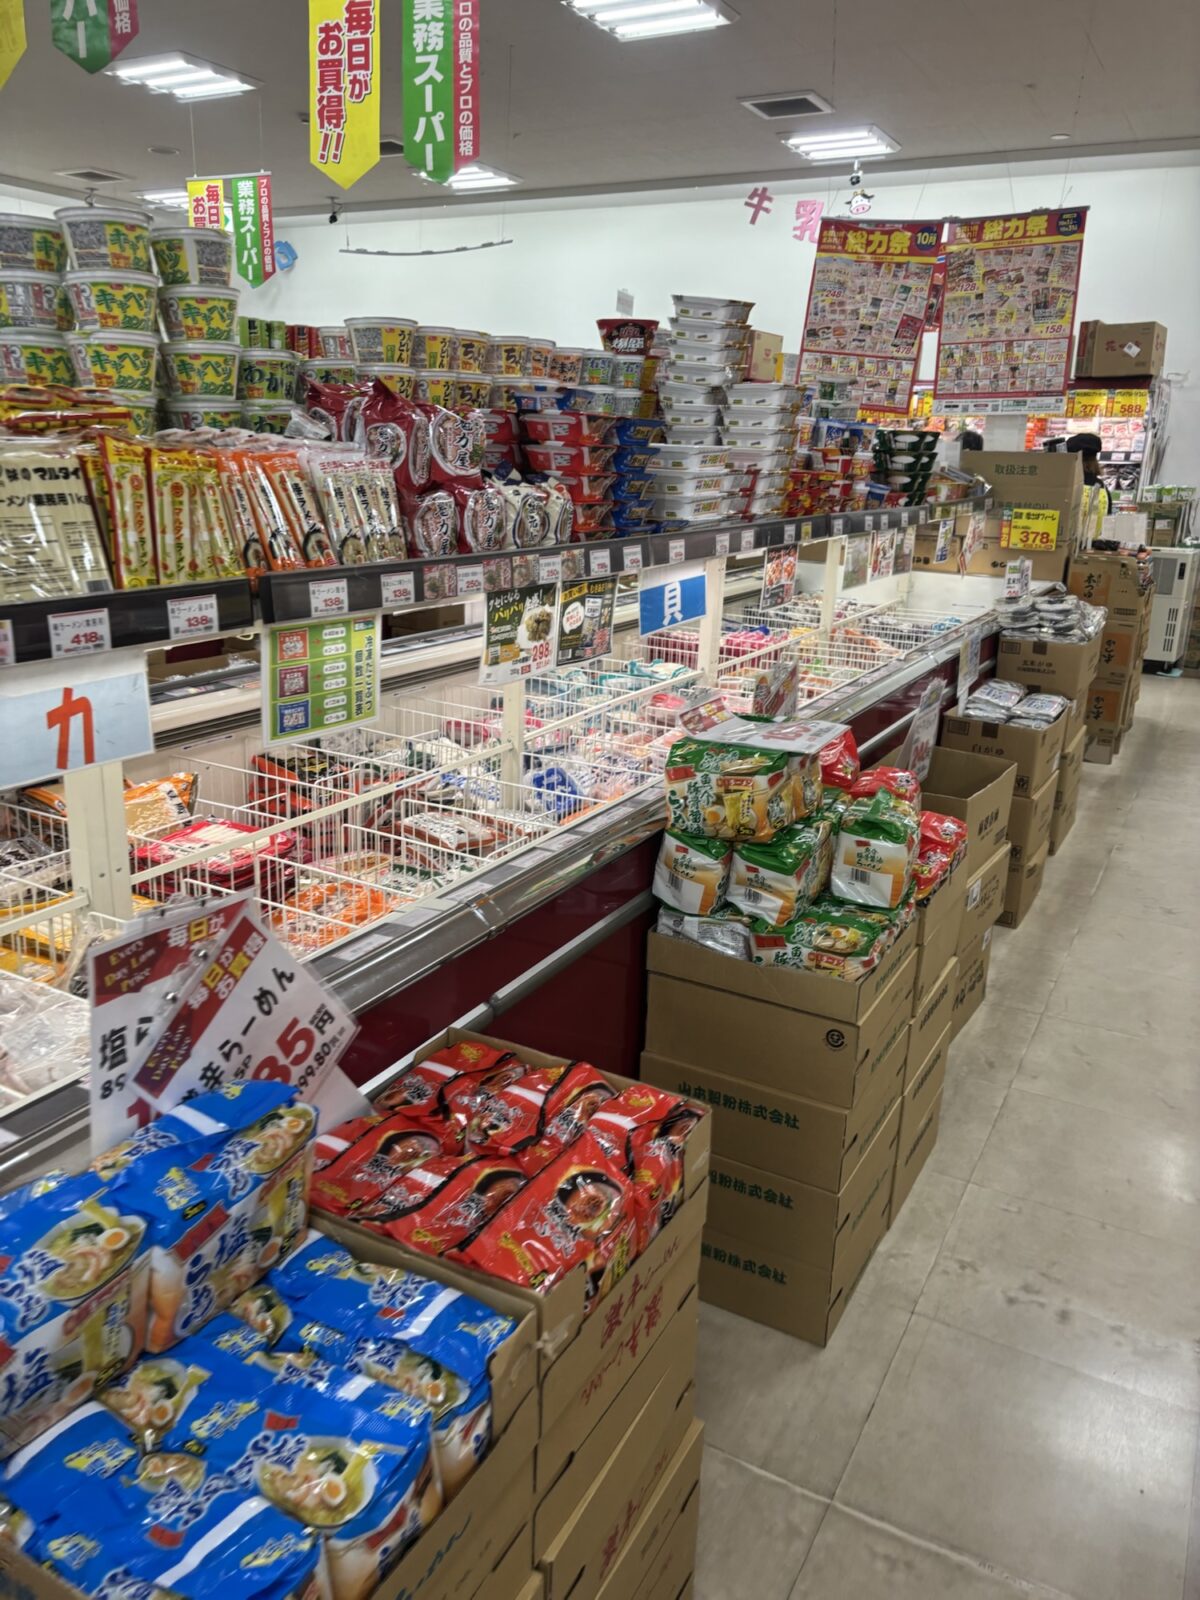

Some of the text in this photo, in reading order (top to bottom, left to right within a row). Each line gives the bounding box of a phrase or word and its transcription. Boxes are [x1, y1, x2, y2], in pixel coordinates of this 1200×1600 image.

[345, 0, 372, 100] 毎日が
[413, 0, 445, 171] 業務スーパー
[744, 186, 774, 225] 牛
[237, 180, 258, 280] 業務スーパー
[792, 199, 824, 243] 乳
[983, 215, 1048, 241] 総力祭
[845, 230, 912, 254] 総力祭
[916, 232, 937, 245] 10月
[994, 464, 1038, 476] 取扱注意
[1019, 531, 1050, 545] 378
[663, 581, 683, 626] 貝
[186, 616, 210, 628] 138
[71, 631, 99, 645] 418
[532, 642, 550, 662] 298
[167, 914, 226, 947] 毎日が
[212, 932, 267, 1000] お買得
